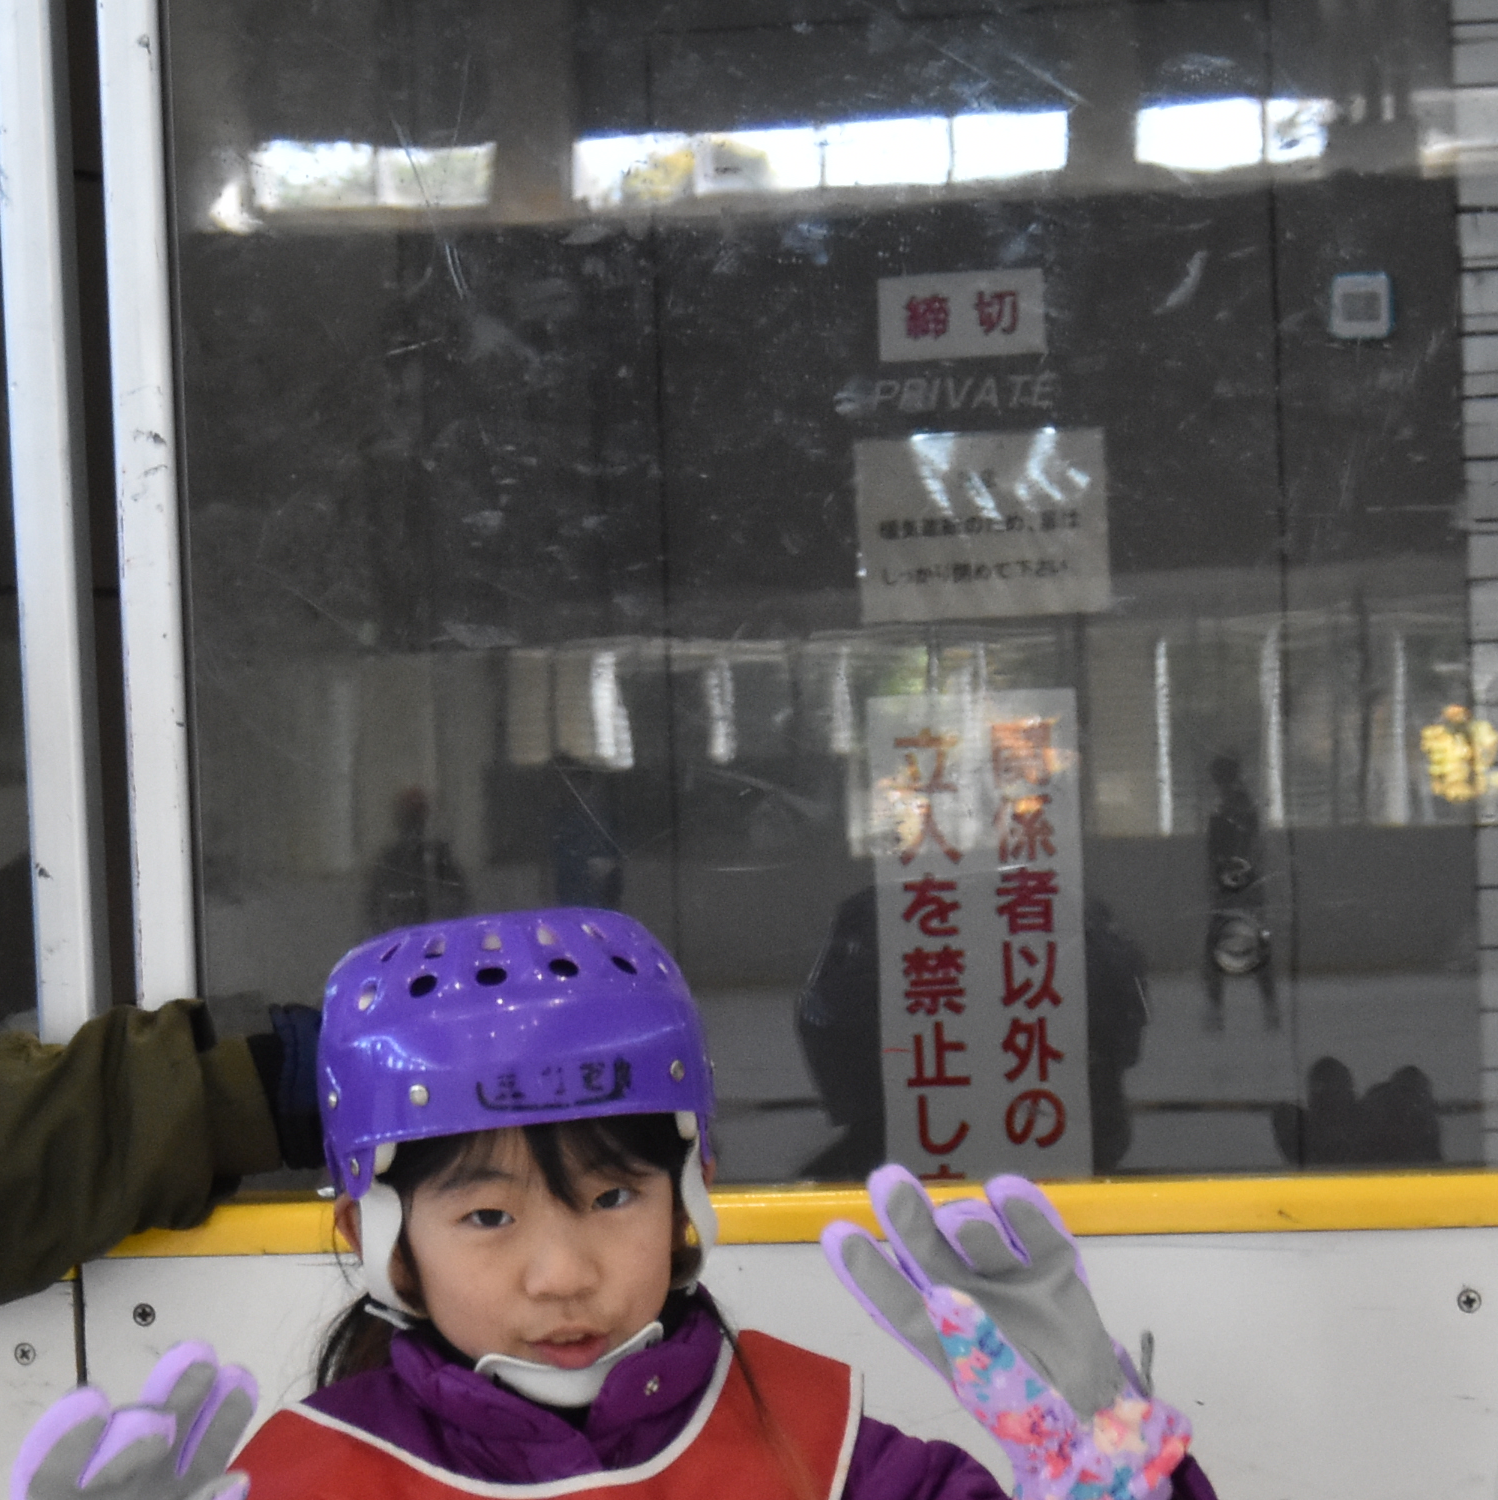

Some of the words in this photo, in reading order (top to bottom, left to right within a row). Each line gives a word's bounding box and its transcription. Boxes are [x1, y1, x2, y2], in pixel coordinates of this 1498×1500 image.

[905, 290, 1019, 340] 締切
[873, 372, 1057, 412] PRIVATE
[991, 720, 1067, 1148] 関係者以外の
